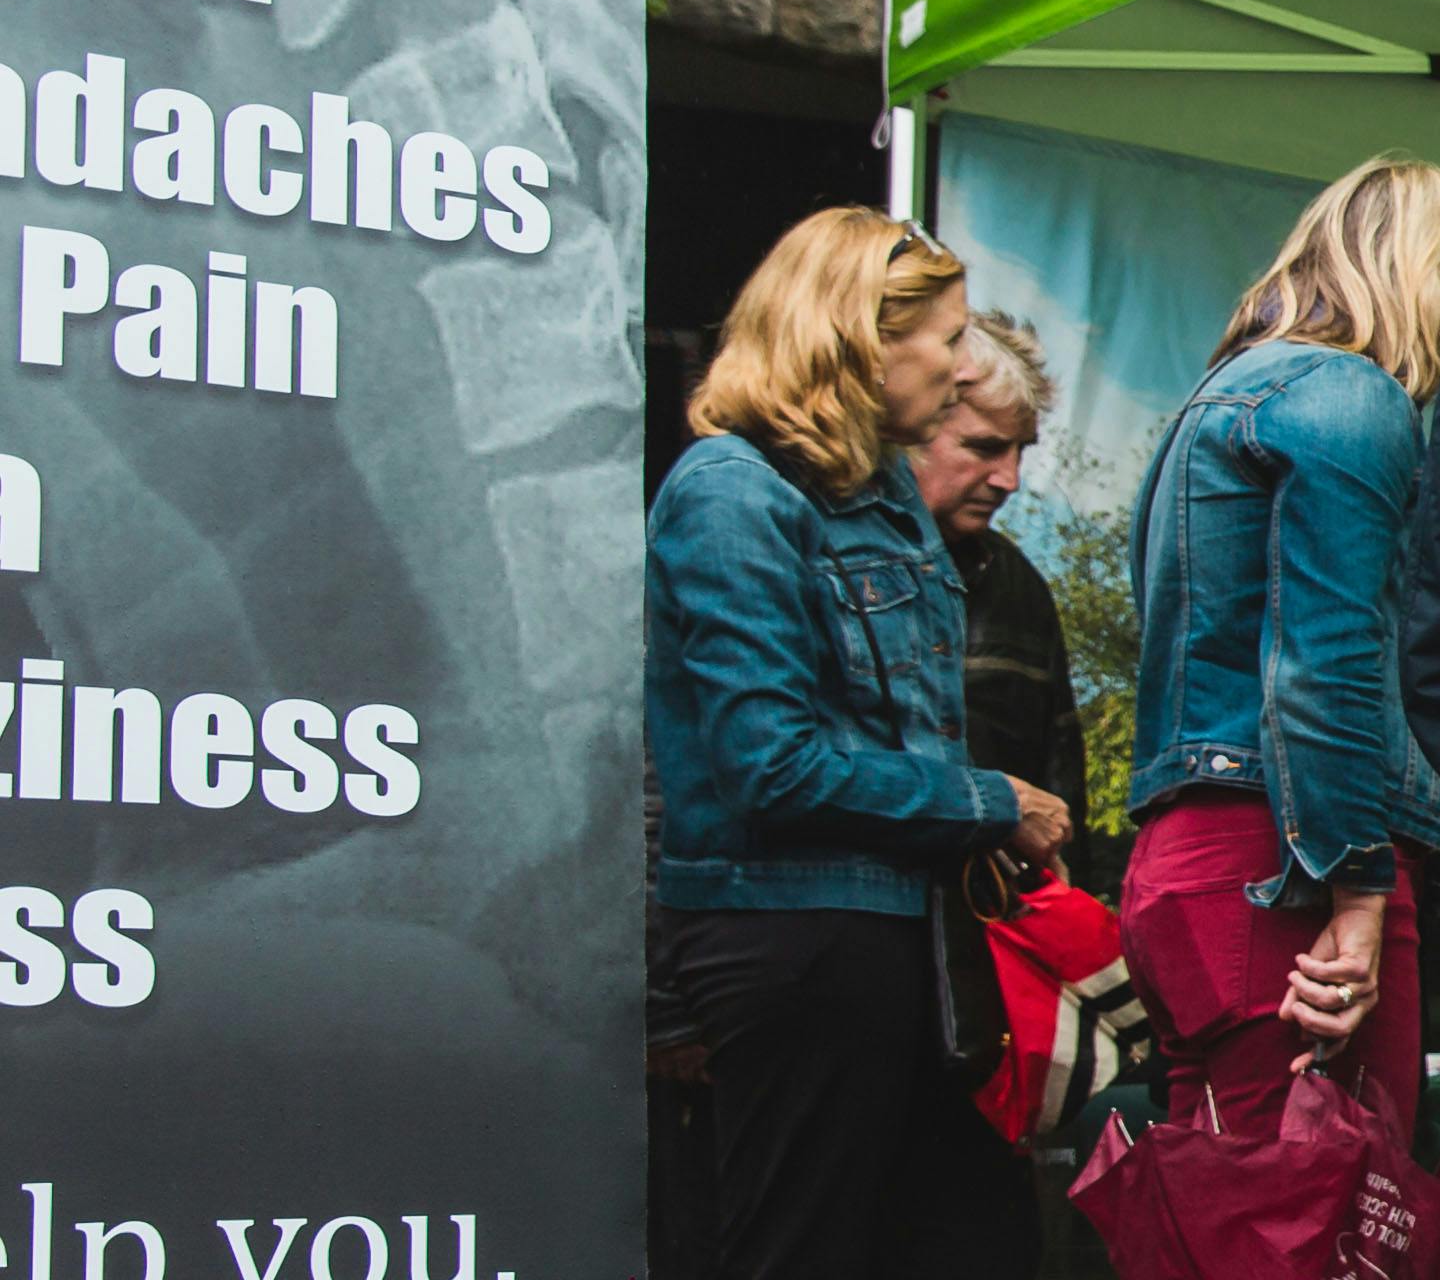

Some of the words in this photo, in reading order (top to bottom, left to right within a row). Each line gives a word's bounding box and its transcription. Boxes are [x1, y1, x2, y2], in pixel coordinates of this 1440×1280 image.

[0, 53, 552, 254] daches
[20, 224, 338, 400] Pain
[0, 659, 421, 817] iness
